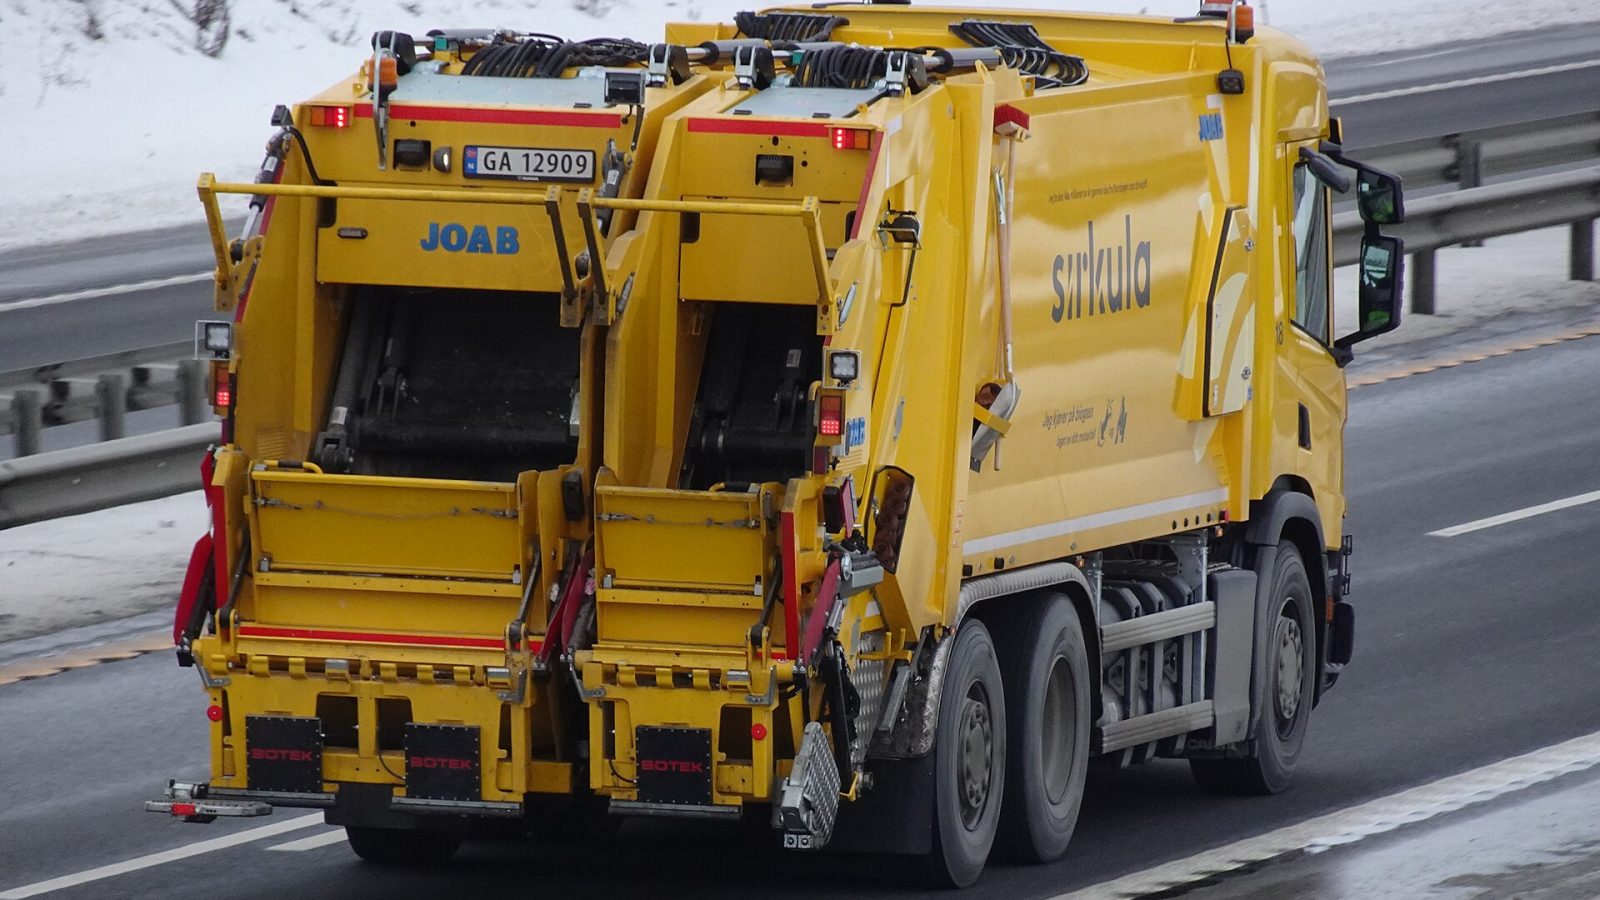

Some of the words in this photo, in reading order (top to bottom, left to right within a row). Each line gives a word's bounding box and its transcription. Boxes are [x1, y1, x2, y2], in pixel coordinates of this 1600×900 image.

[483, 150, 512, 172] GA
[521, 151, 588, 175] 12909
[420, 222, 520, 255] JOAB
[1051, 213, 1151, 323] sirkula
[1275, 321, 1284, 345] 18
[251, 748, 313, 761] BOTEK
[410, 756, 473, 769] BOTEK
[640, 760, 704, 772] BOTEK
